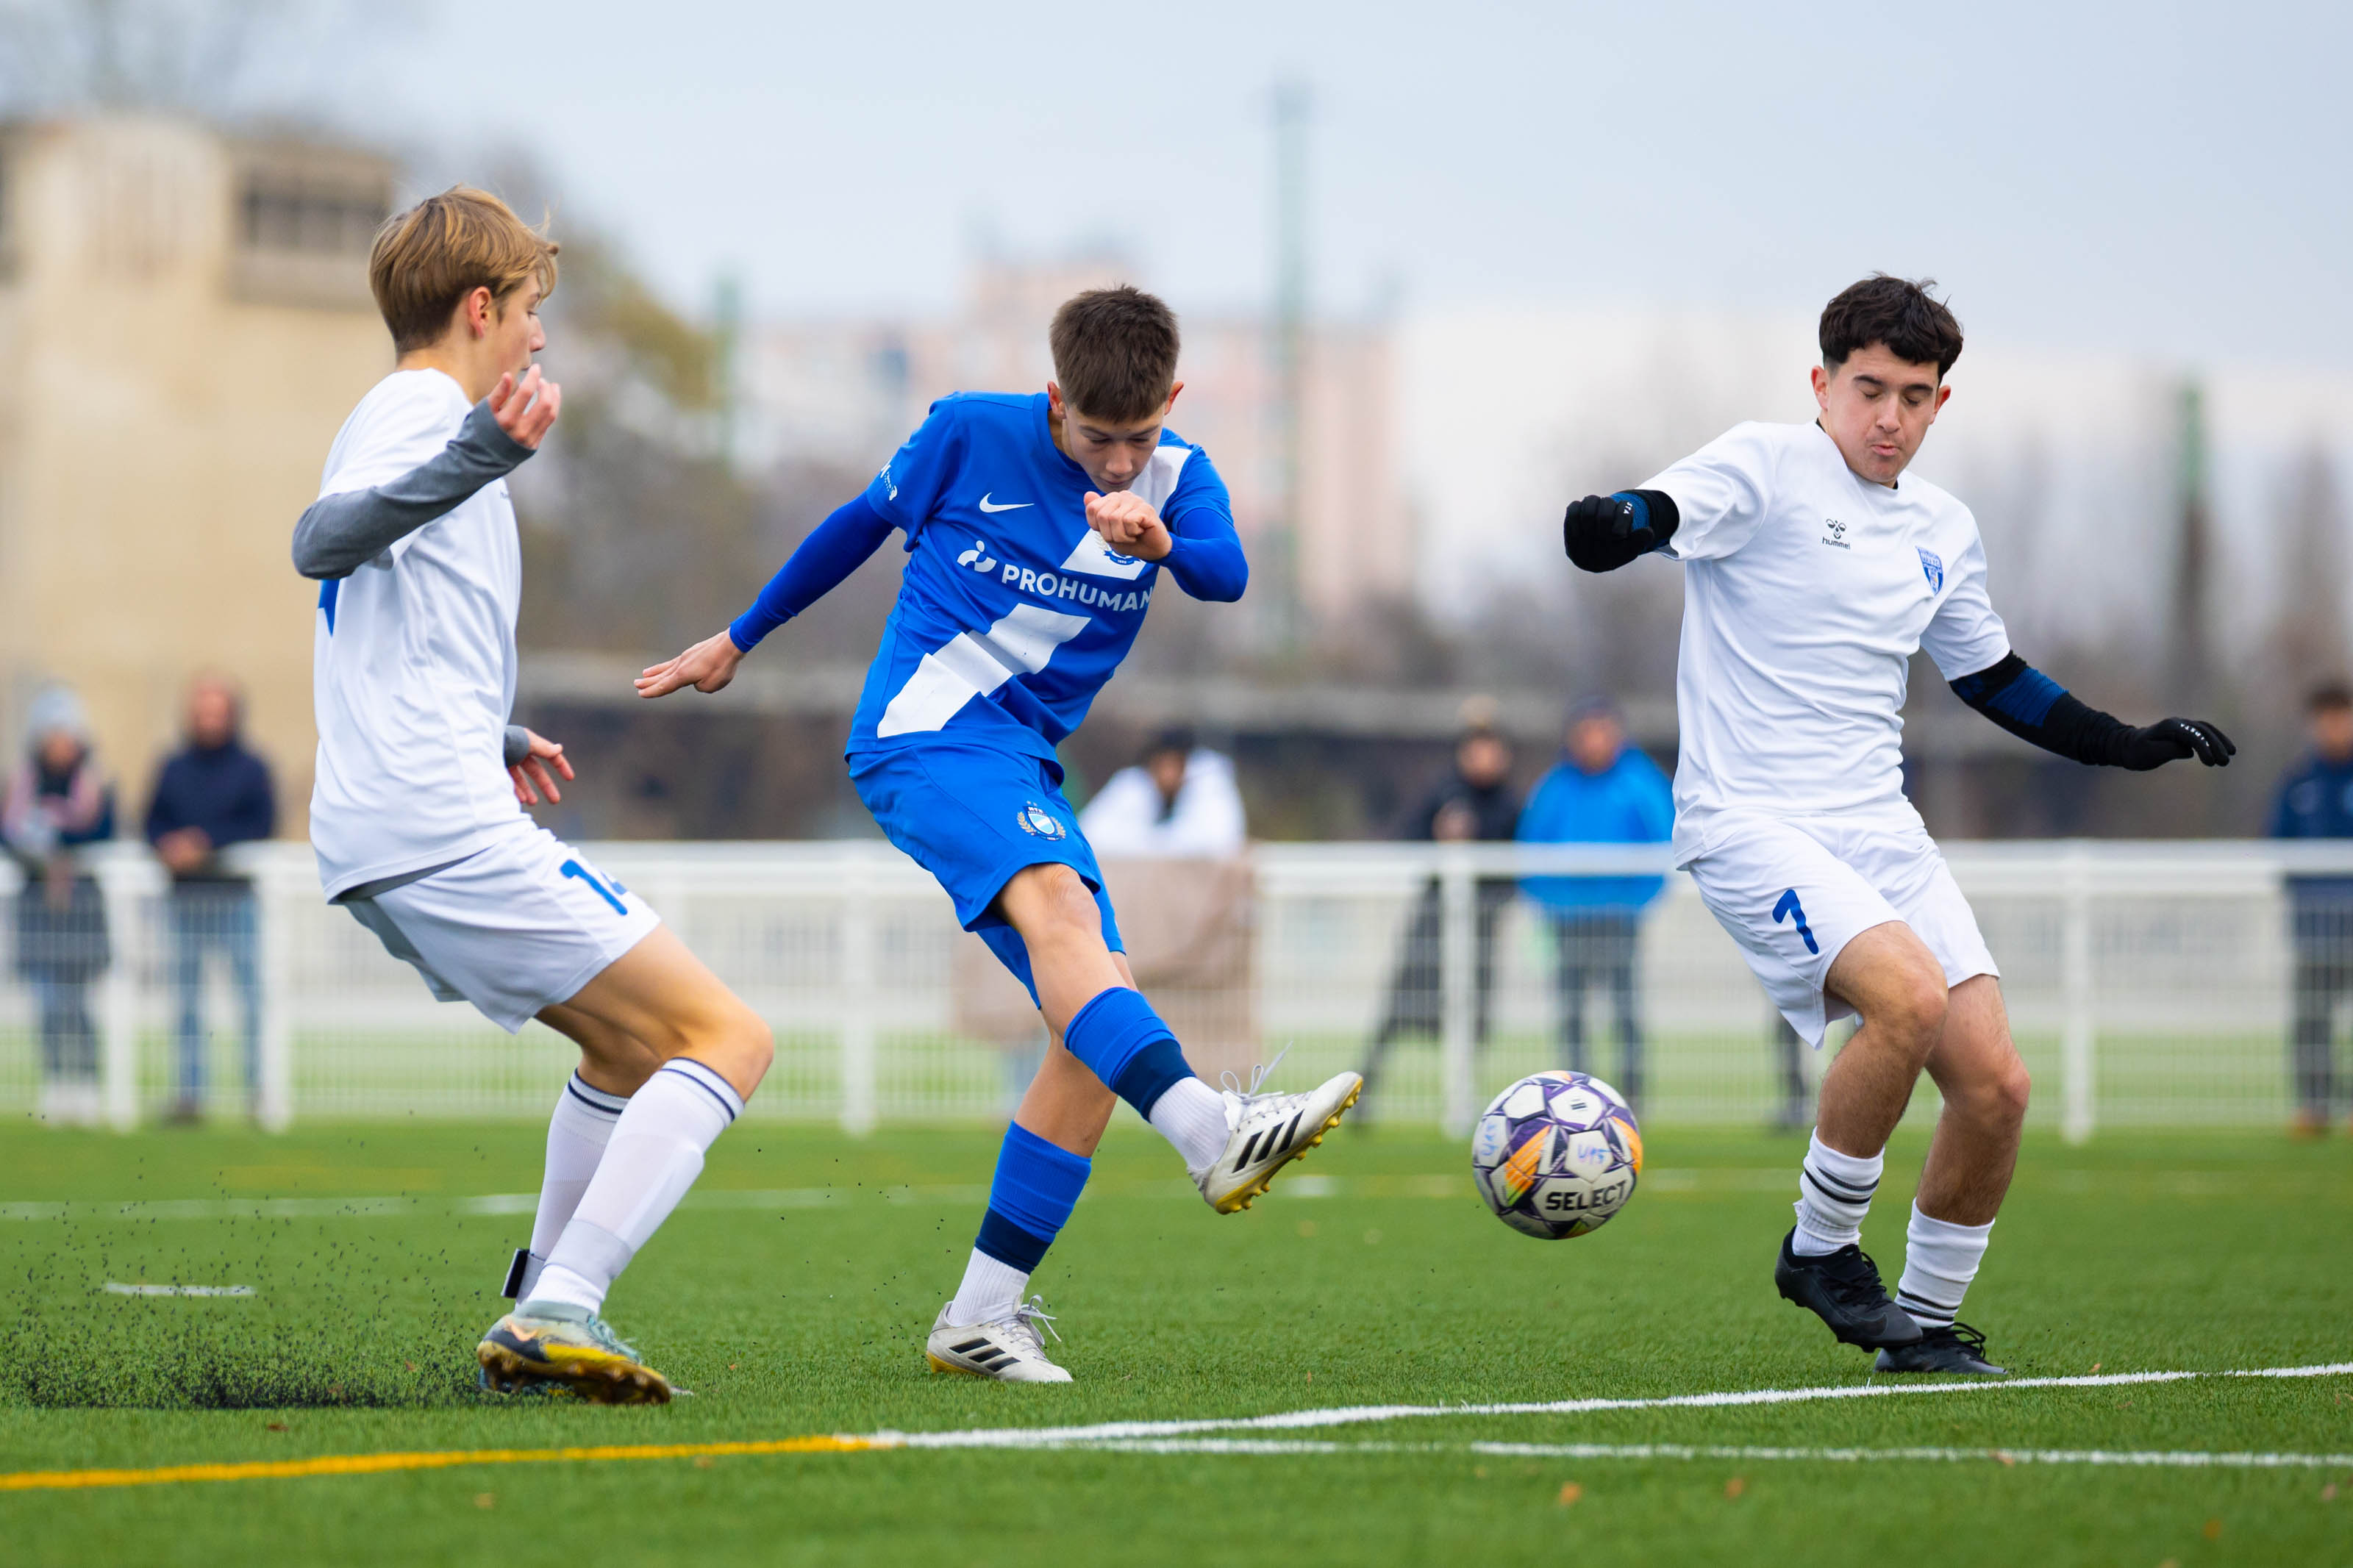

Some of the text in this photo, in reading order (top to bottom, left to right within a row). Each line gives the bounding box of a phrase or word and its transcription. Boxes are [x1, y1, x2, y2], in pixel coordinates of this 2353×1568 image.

[1822, 536, 1850, 550] hummel
[1001, 564, 1153, 612] PROHUMAN
[1545, 1179, 1627, 1211] SELECT
